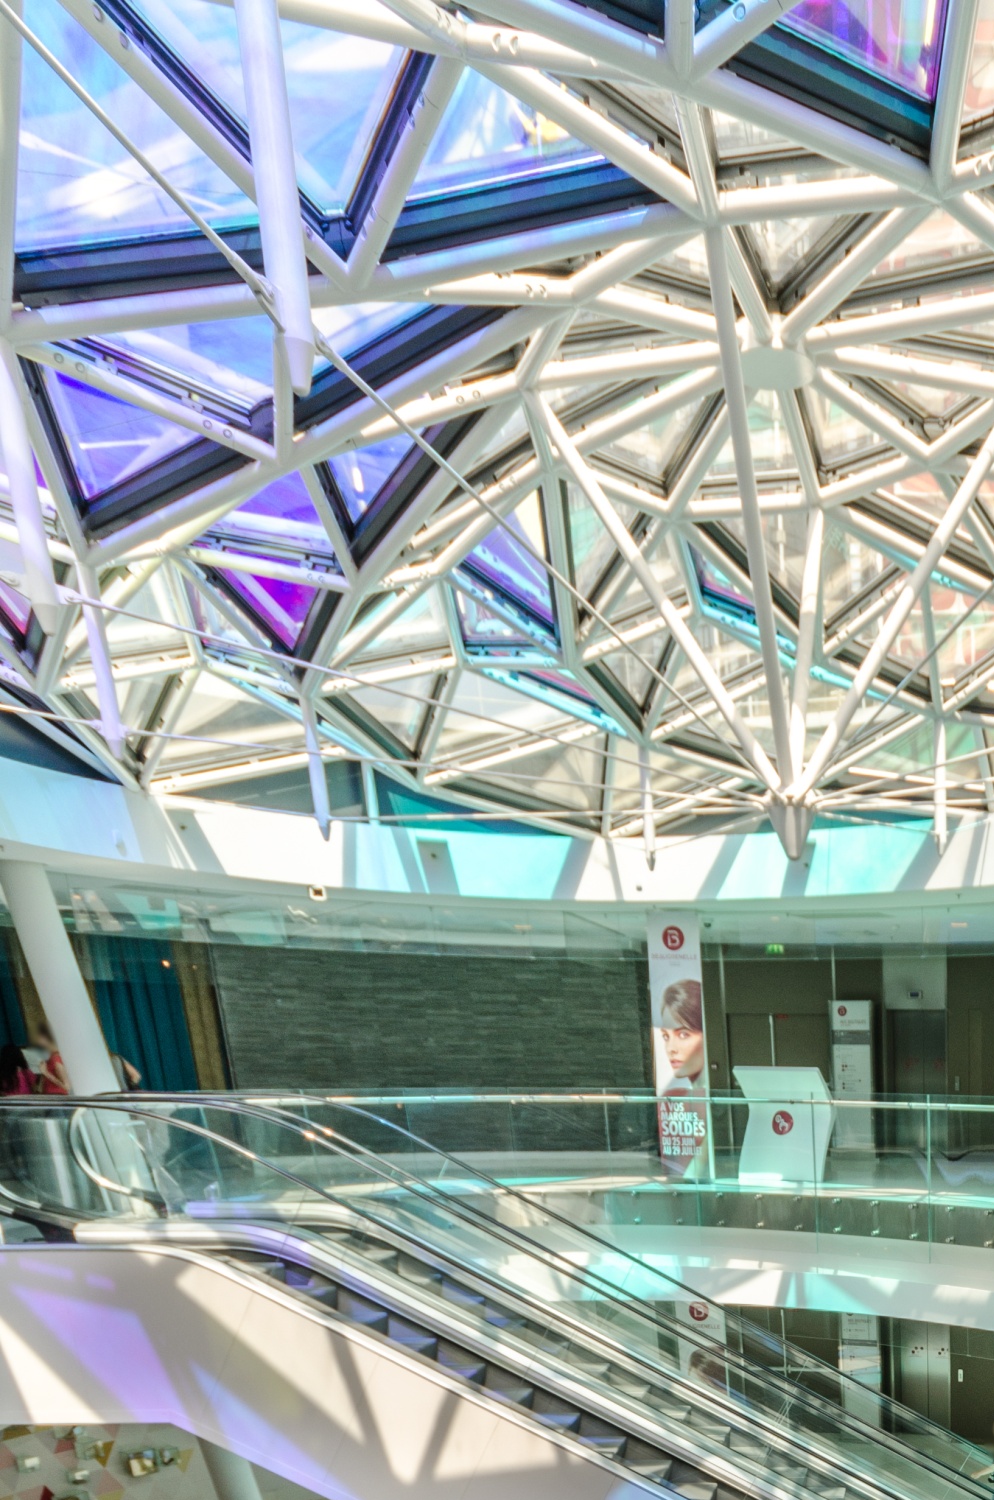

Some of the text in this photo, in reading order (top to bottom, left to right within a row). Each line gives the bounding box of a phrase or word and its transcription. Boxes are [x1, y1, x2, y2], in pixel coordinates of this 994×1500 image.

[667, 1102, 684, 1112] VOS
[662, 1120, 706, 1136] SOLDES
[672, 1136, 681, 1146] 25
